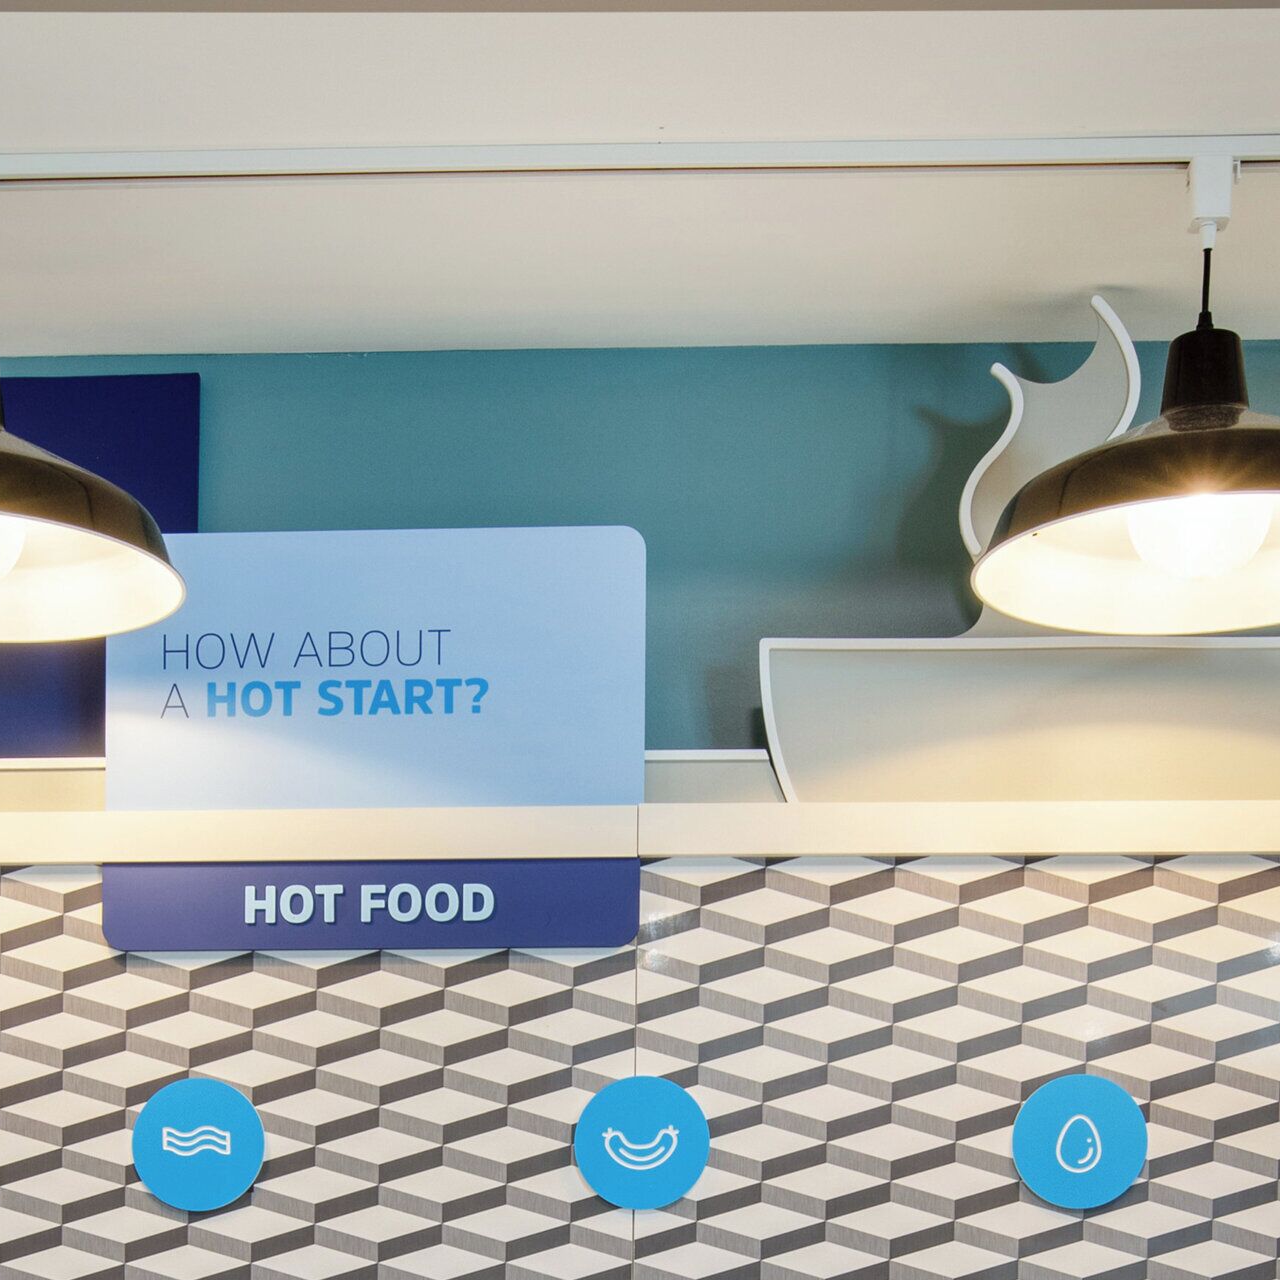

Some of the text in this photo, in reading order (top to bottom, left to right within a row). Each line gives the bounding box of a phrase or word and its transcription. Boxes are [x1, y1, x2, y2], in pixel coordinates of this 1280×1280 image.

[162, 629, 452, 670] HOW ABOUT
[160, 677, 489, 719] A HOT START?
[244, 882, 495, 925] HOT FOOD
